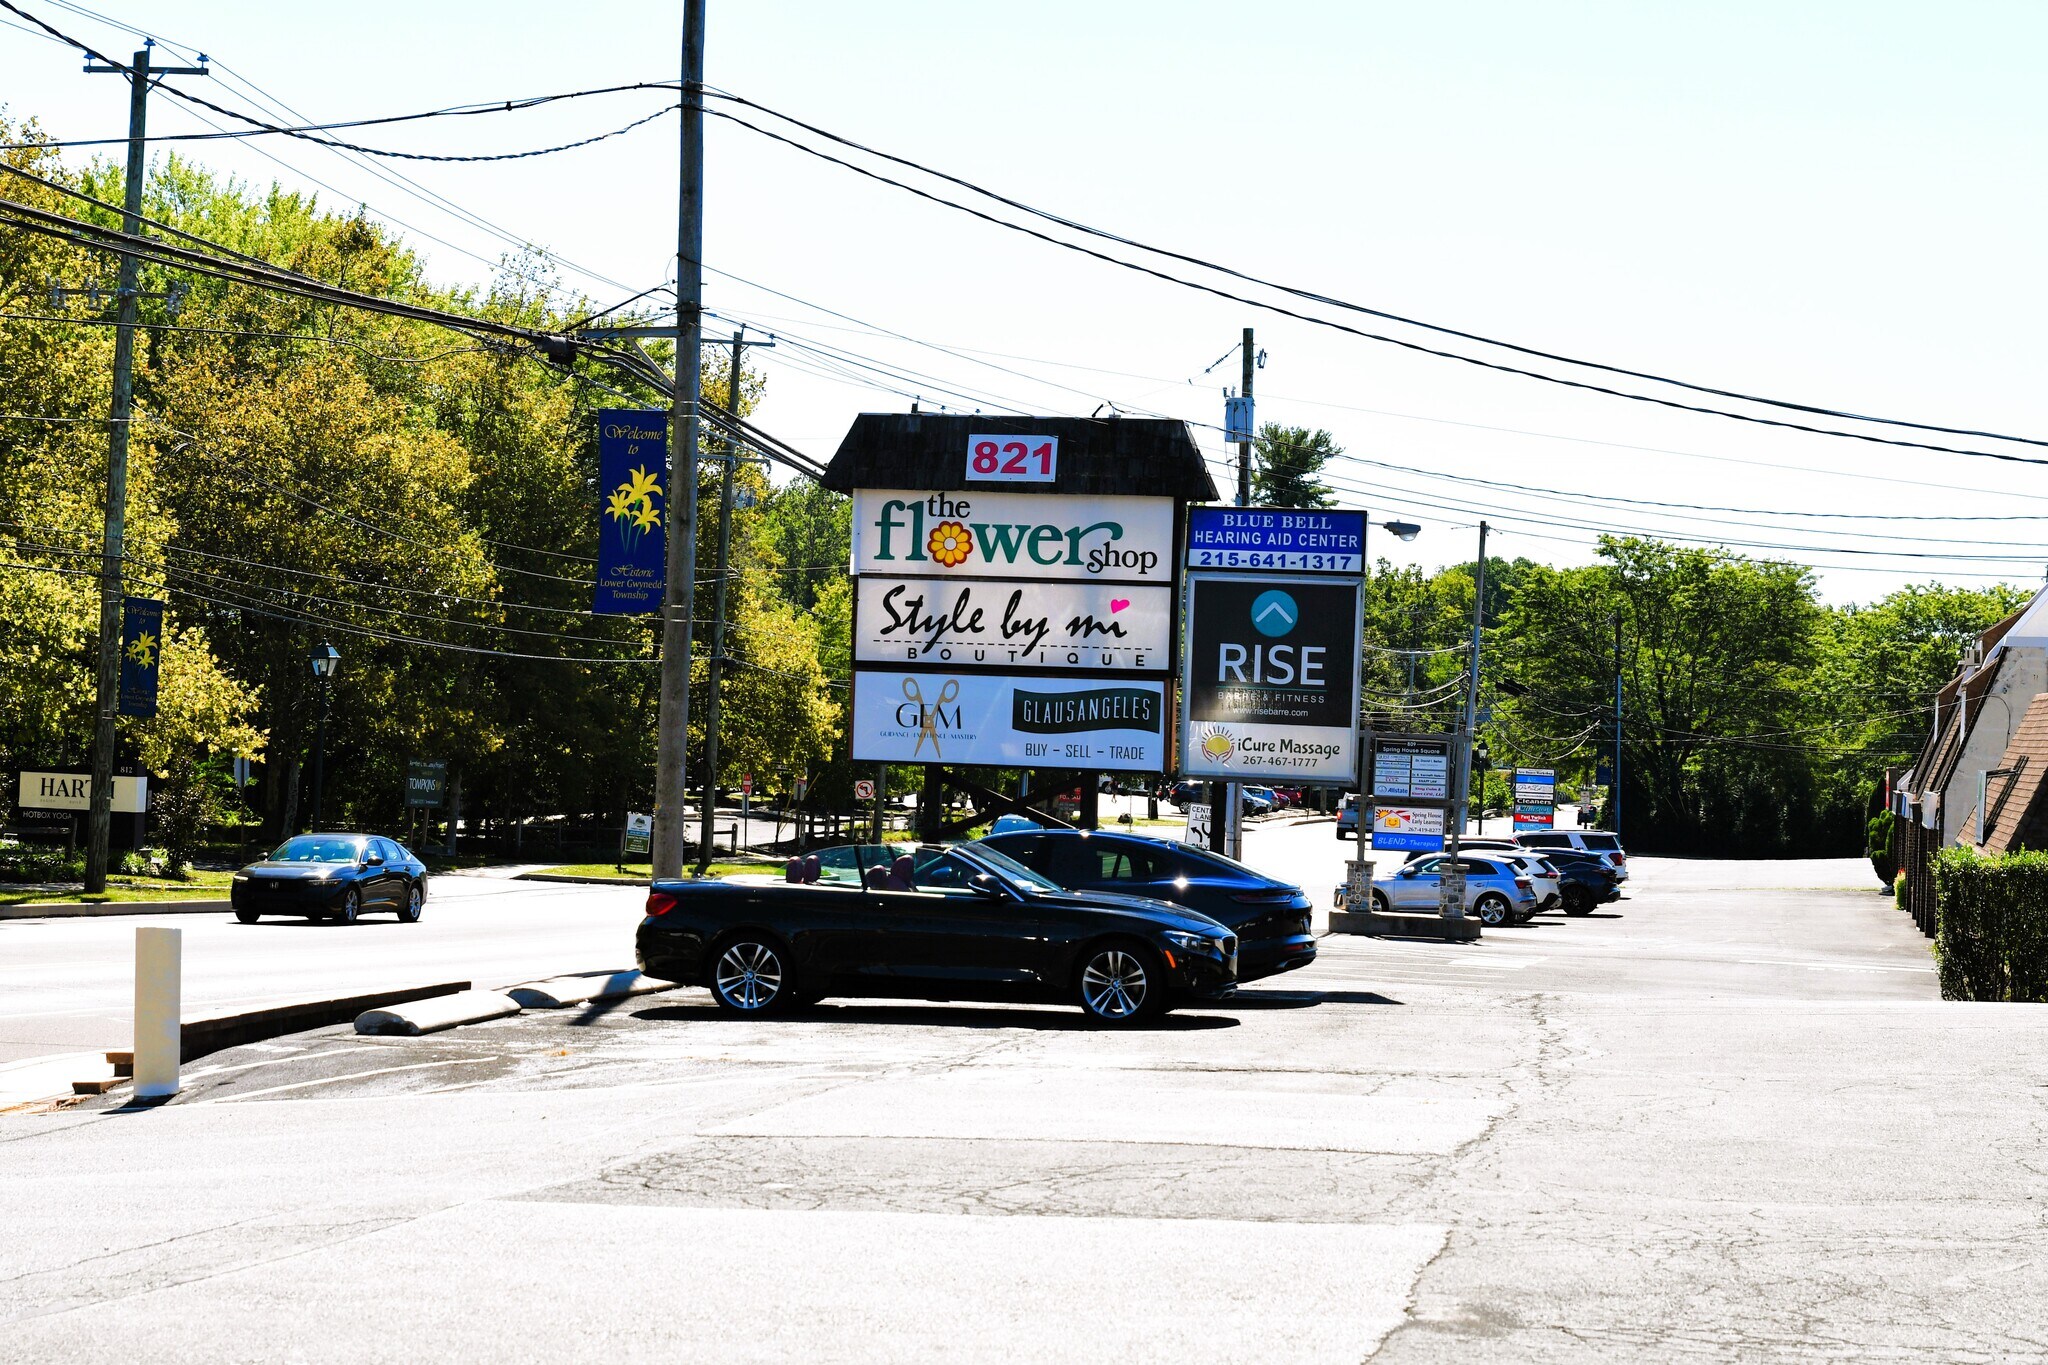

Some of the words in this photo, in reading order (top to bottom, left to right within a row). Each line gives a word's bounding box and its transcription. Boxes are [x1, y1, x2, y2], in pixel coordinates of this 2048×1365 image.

[605, 424, 664, 440] Welcome
[628, 444, 639, 454] to
[972, 441, 1053, 475] 821
[928, 492, 970, 518] the
[1222, 514, 1274, 528] BLUE
[1281, 515, 1332, 530] BELL
[1195, 530, 1262, 545] HEARING
[1267, 532, 1292, 546] AID
[1298, 533, 1359, 548] CENTER
[1087, 541, 1158, 574] shop
[1200, 551, 1352, 570] 215-641-1317
[611, 564, 655, 577] Historic
[600, 578, 625, 588] Lower
[627, 579, 662, 591] Gwynedd
[611, 589, 649, 601] Township
[880, 584, 985, 654] Style
[1001, 589, 1050, 656] by
[1066, 599, 1131, 638] mi
[907, 647, 1145, 667] BOUTIQUE
[1218, 643, 1327, 686] RISE
[1217, 692, 1257, 700] BARRE
[1275, 694, 1325, 704] FITNESS
[896, 703, 962, 729] GEM
[1023, 695, 1152, 724] GLAUSANGELES
[1233, 708, 1309, 717] www.risebarre.com
[1025, 743, 1048, 757] BUY
[1066, 744, 1091, 758] SELL
[1110, 745, 1144, 760] TRADE
[1237, 738, 1277, 753] iCure
[1280, 739, 1341, 759] Massage
[1242, 755, 1318, 768] 267-467-1777
[409, 778, 436, 793] TOMPKINS
[23, 811, 51, 819] HOTBOX
[1423, 819, 1442, 827] Learning
[1378, 837, 1406, 845] BLEND
[1410, 839, 1438, 848] Therapies
[1354, 872, 1362, 904] 809
